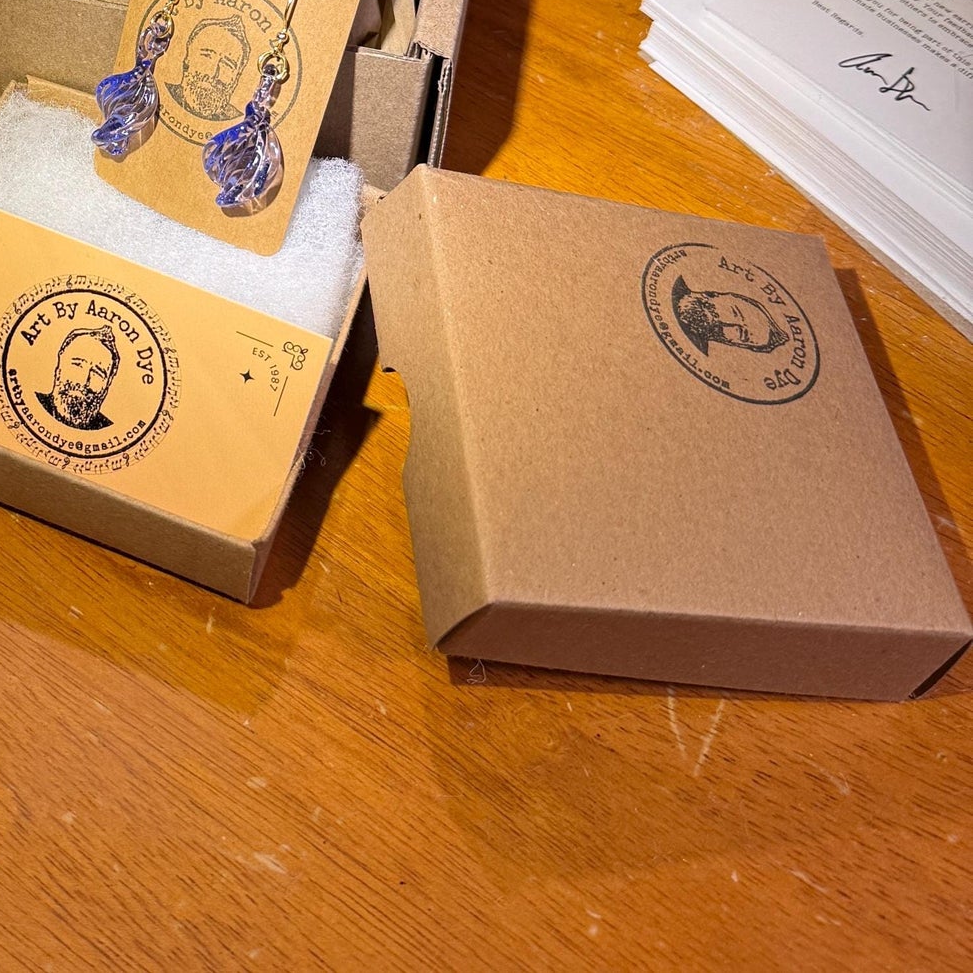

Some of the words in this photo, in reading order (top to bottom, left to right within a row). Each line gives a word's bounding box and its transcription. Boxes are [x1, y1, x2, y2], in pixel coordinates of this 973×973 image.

[718, 256, 755, 283] Art
[760, 282, 786, 307] By
[21, 312, 51, 346] Art
[53, 301, 79, 320] By
[85, 299, 140, 343] Aaron
[136, 346, 155, 385] Dye
[648, 248, 731, 390] artbyaarondye@gmail.com
[785, 314, 807, 370] Aaron
[252, 347, 272, 362] EST
[269, 364, 280, 392] 1987
[764, 367, 801, 391] Dye
[8, 368, 147, 454] artbyaarondye@gmail.com
